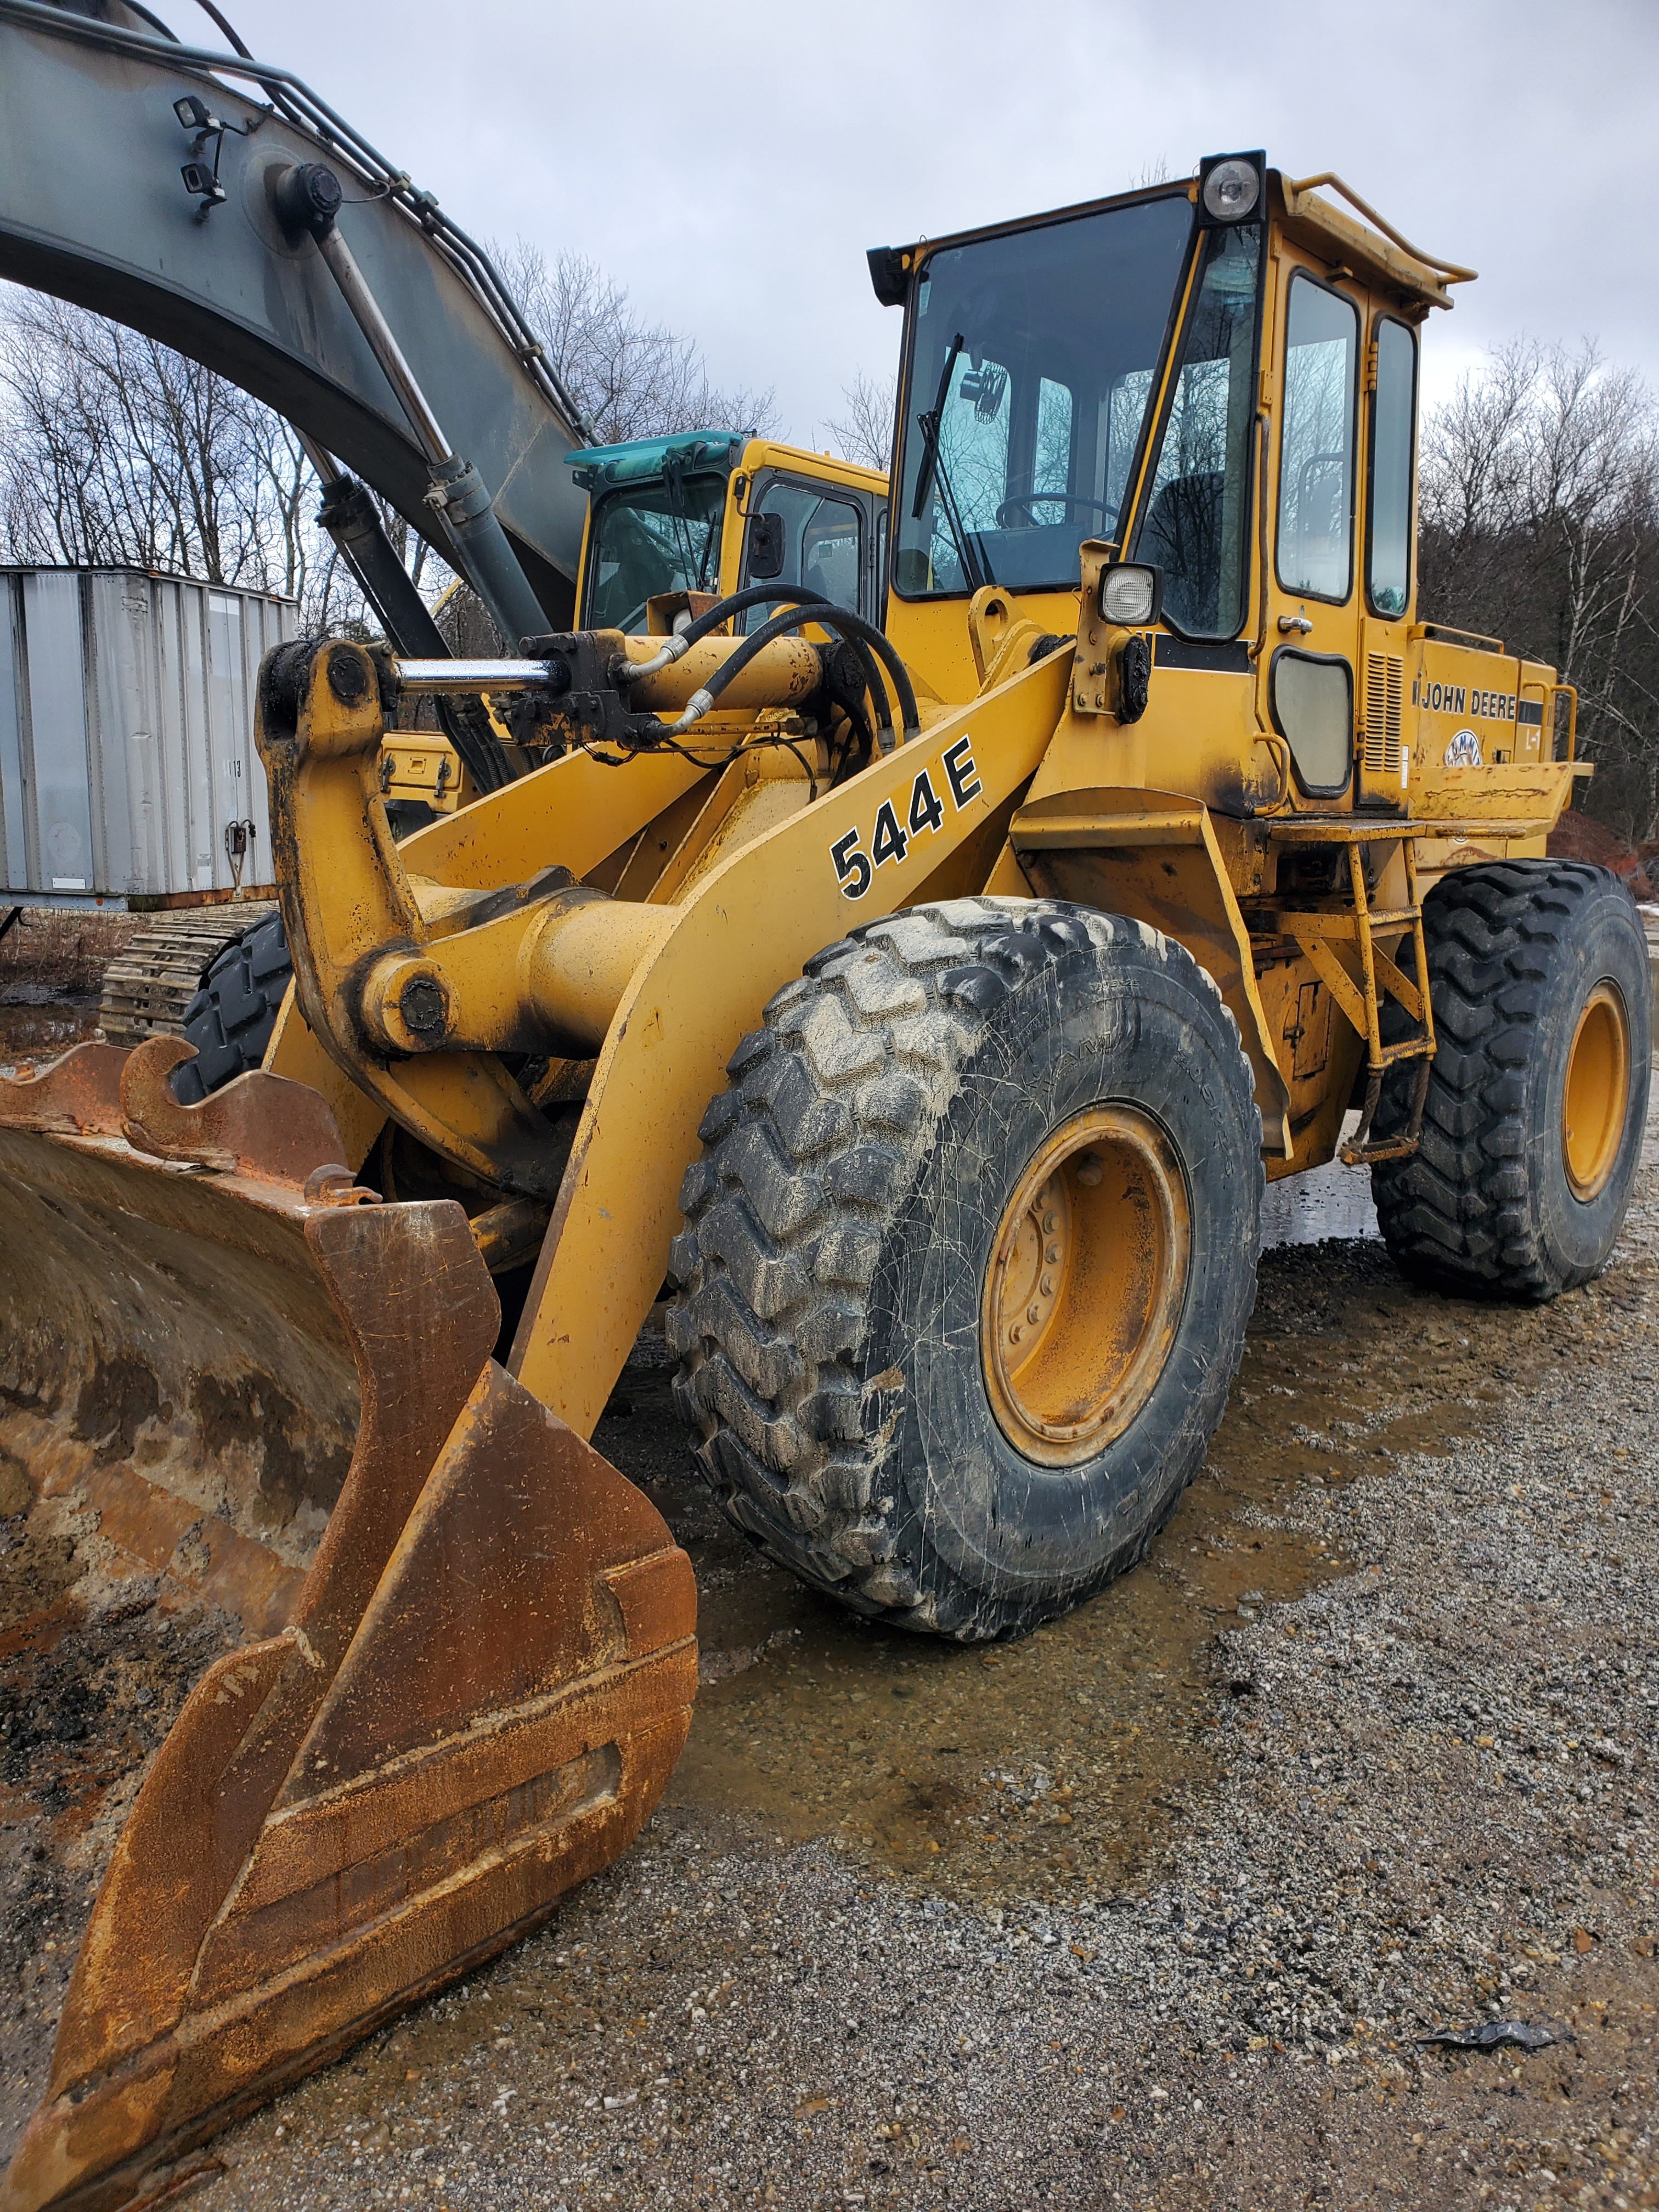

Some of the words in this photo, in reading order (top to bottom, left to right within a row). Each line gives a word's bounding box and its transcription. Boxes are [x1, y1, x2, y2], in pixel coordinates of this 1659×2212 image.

[1421, 681, 1465, 715] JOHN
[1471, 688, 1516, 721] DEERE
[829, 733, 984, 901] 544E
